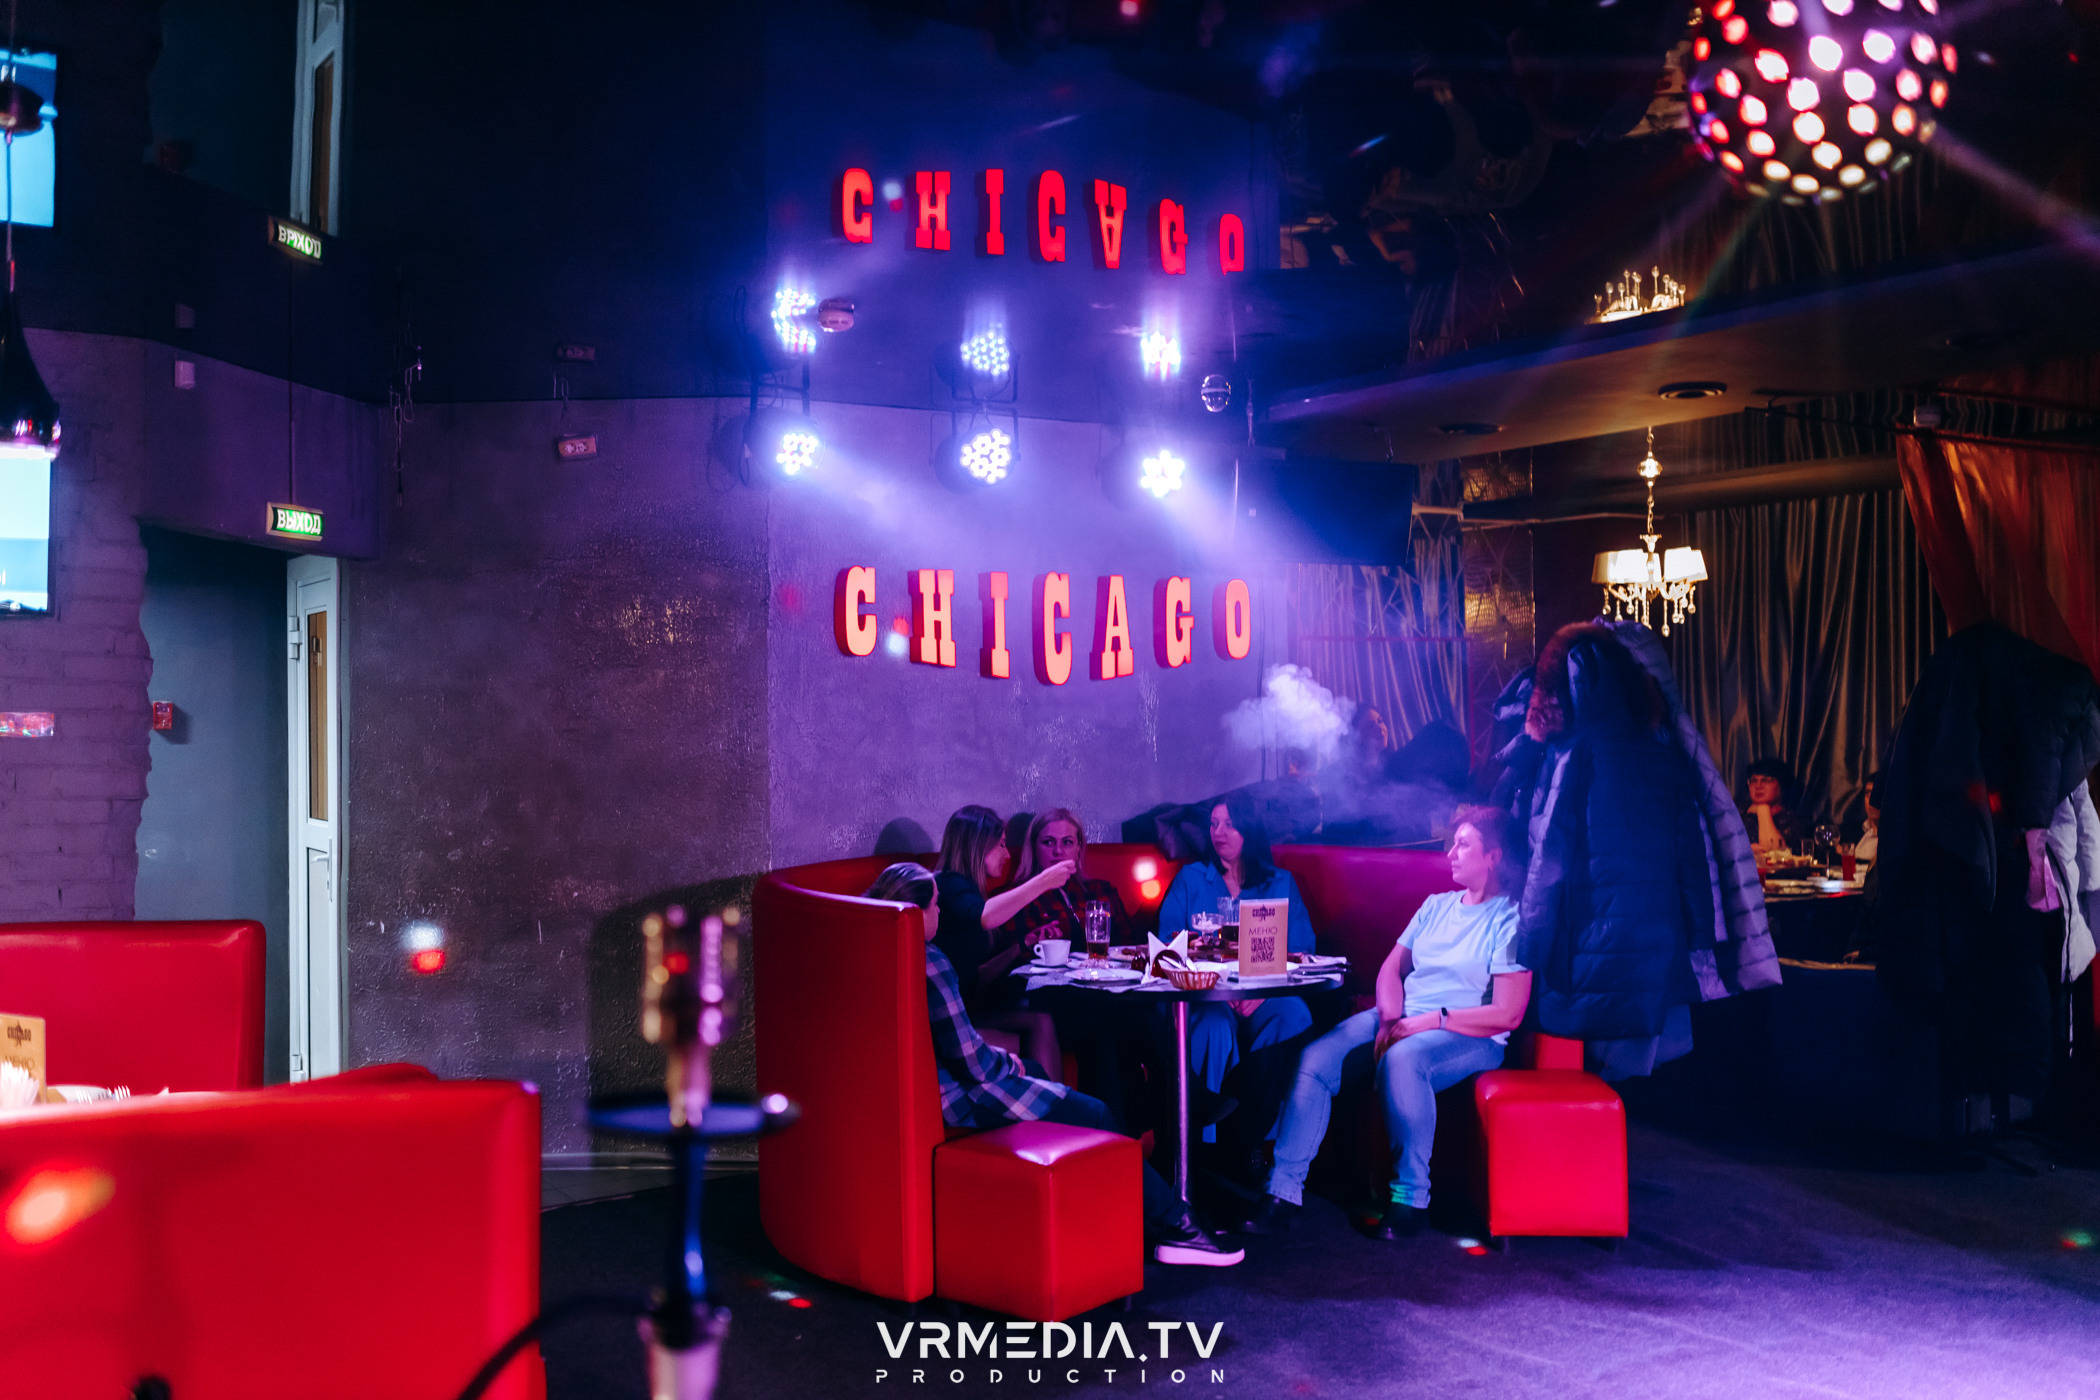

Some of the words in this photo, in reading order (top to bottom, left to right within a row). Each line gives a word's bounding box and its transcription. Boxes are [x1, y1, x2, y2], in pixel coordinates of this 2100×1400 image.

[276, 508, 321, 535] ВЫХОД
[834, 565, 1251, 685] CHICAGO
[1248, 926, 1278, 936] МЕНЮ
